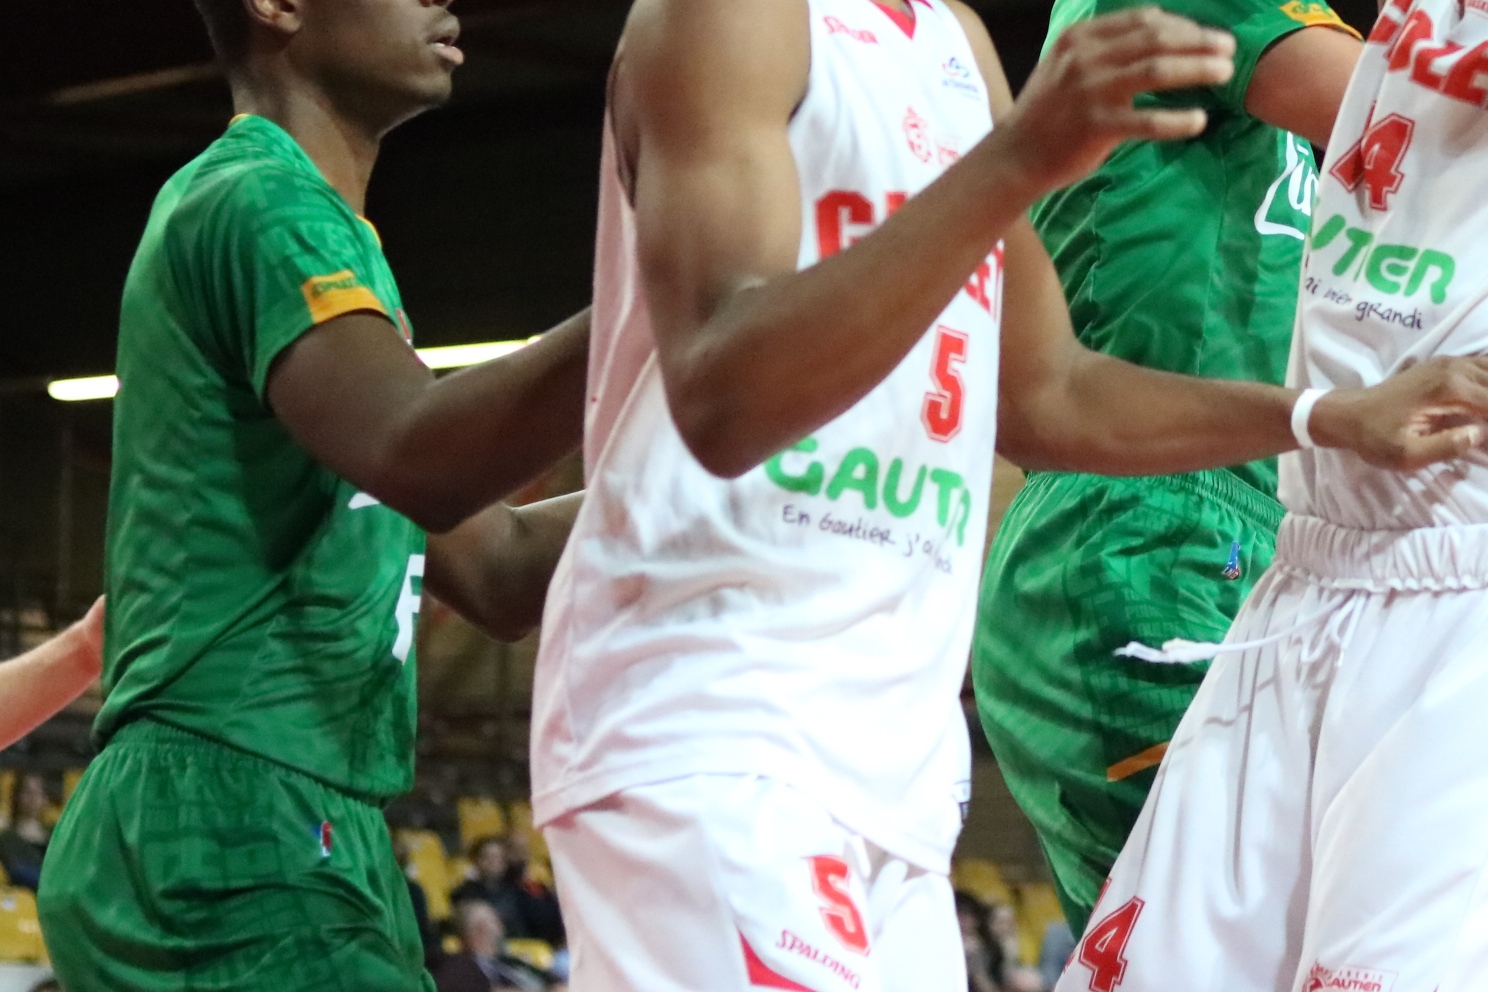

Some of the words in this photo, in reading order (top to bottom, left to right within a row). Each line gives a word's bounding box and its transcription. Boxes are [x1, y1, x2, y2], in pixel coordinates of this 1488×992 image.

[1329, 102, 1414, 213] 4
[920, 324, 970, 444] 5
[776, 928, 863, 991] SPALDING
[803, 854, 871, 958] 5
